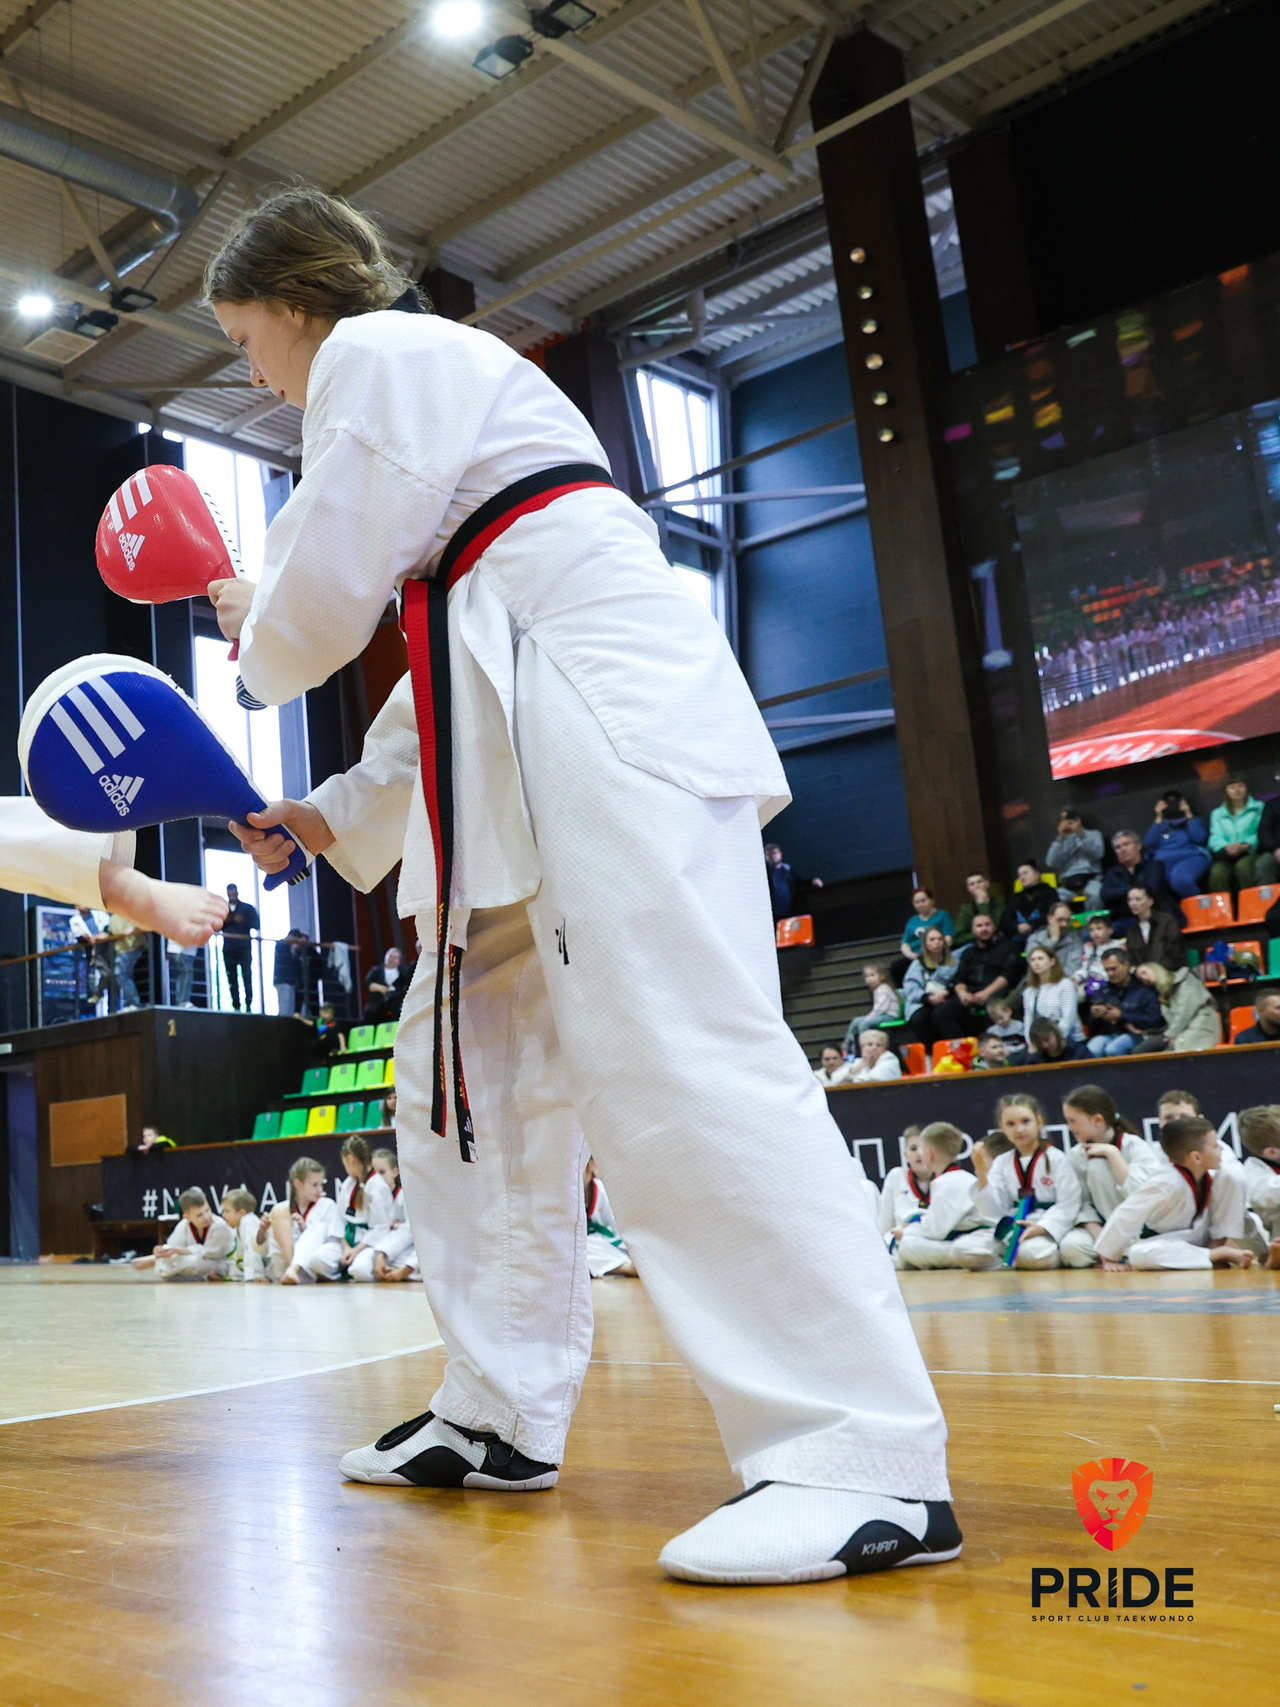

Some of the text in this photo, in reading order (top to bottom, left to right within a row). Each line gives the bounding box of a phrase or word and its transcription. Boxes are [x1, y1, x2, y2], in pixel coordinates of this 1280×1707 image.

[118, 533, 136, 571] adidas
[98, 774, 130, 817] adidas
[861, 1539, 898, 1556] KHAN
